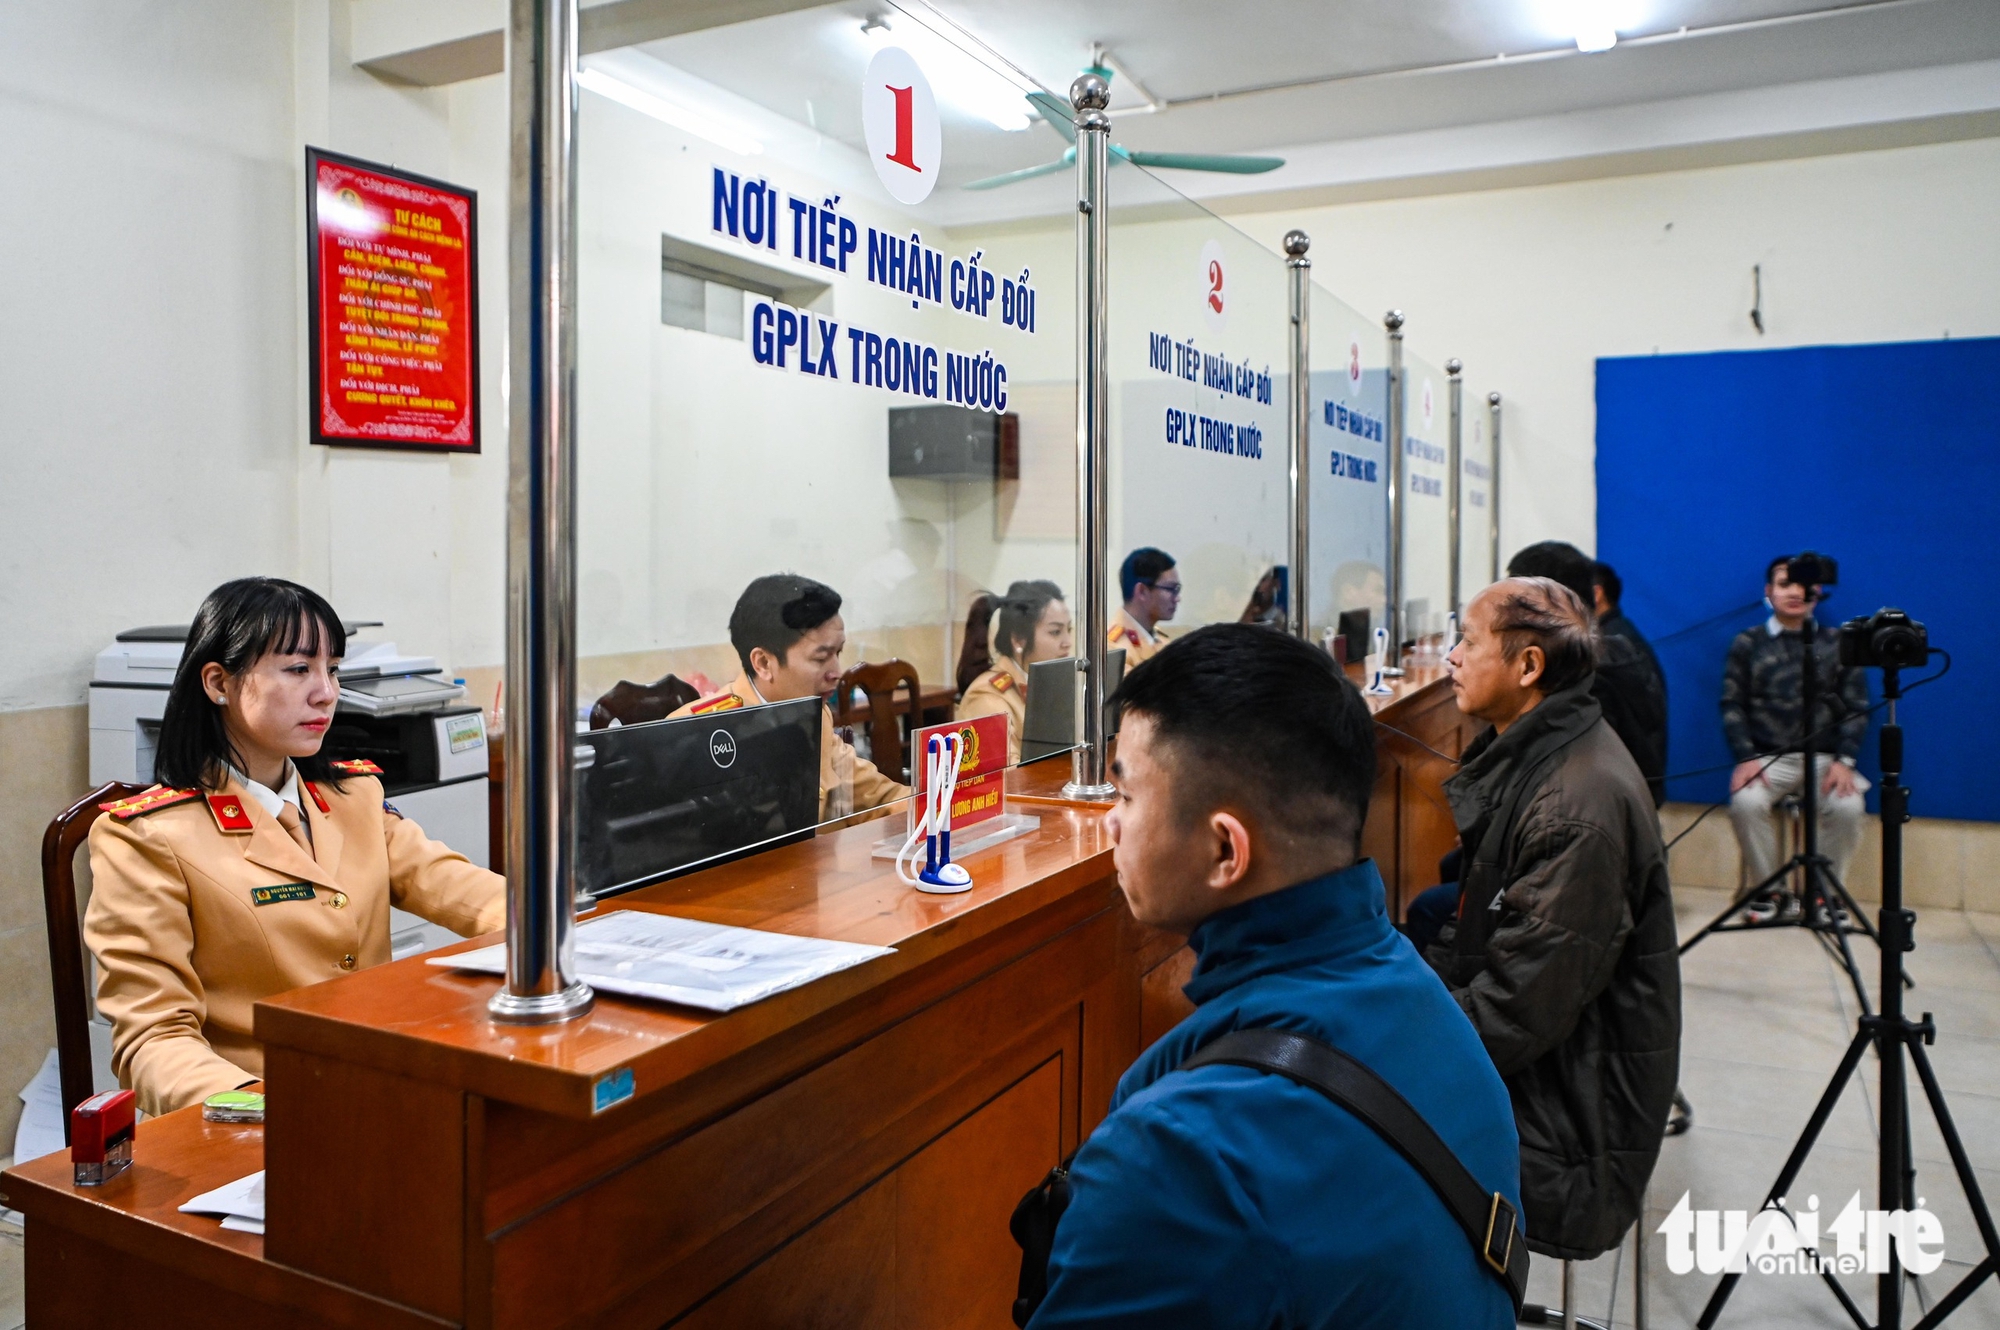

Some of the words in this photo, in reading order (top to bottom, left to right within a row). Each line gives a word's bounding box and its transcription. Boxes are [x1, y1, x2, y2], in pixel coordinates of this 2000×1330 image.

[886, 84, 922, 173] 1
[394, 208, 410, 225] TƯ
[412, 211, 442, 232] CÁCH
[713, 167, 777, 250] NƠI
[789, 195, 857, 273] TIẾP
[868, 228, 943, 310] NHẬN
[950, 251, 995, 317] CẤP
[1002, 268, 1036, 334] ĐỔI
[1208, 260, 1224, 314] 2
[752, 302, 838, 379] GPLX
[848, 327, 938, 400] TRONG
[946, 350, 1007, 412] NƯỚC
[1150, 331, 1172, 374] NƠI
[1176, 338, 1200, 382] TIẾP
[1204, 352, 1232, 400] NHẬN
[1236, 358, 1254, 400] CẤP
[1256, 364, 1272, 406] ĐỔI
[1166, 408, 1196, 448] GPLX
[1200, 416, 1234, 454] TRONG
[1236, 420, 1262, 460] NƯỚC
[713, 742, 733, 755] DELL
[952, 799, 970, 818] LƯƠNG
[972, 795, 985, 812] ANH
[986, 787, 999, 808] HIẾU
